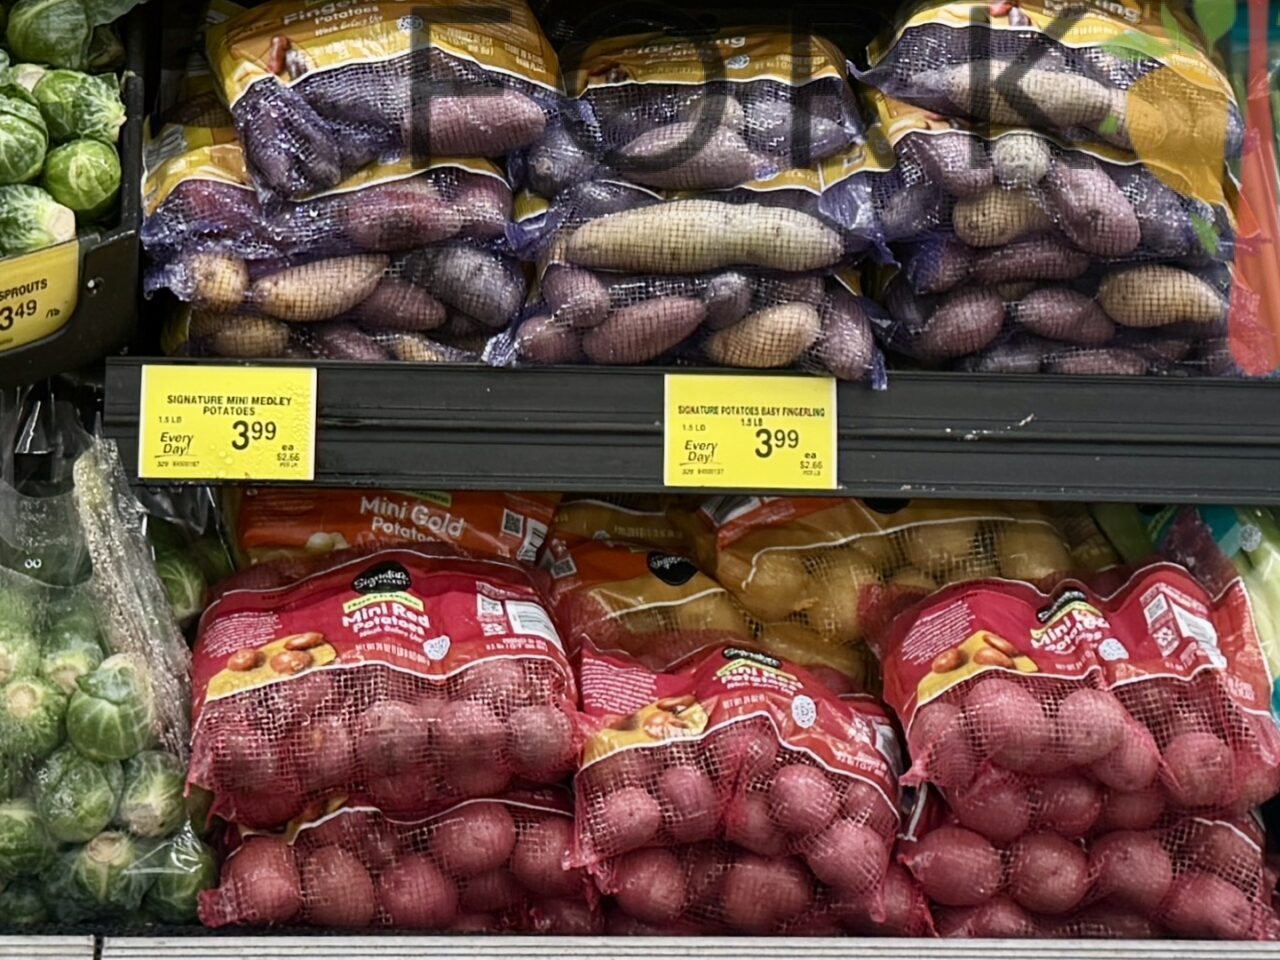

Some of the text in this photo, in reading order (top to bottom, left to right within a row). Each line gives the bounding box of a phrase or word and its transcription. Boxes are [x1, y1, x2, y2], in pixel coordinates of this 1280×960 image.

[314, 4, 380, 25] Potatoes
[167, 394, 292, 406] SIGNATURE MINI MEDLEY
[203, 406, 256, 416] POTATOES
[678, 405, 825, 417] SIGNATURE POTATOES BABY FINGERLING
[160, 431, 194, 445] Every
[163, 443, 190, 456] Day!
[281, 444, 294, 452] ea
[684, 440, 718, 453] Every
[687, 451, 714, 464] Day!
[360, 496, 466, 538] Mini Gold
[342, 603, 430, 629] Mini Red
[353, 615, 425, 635] Potatoes
